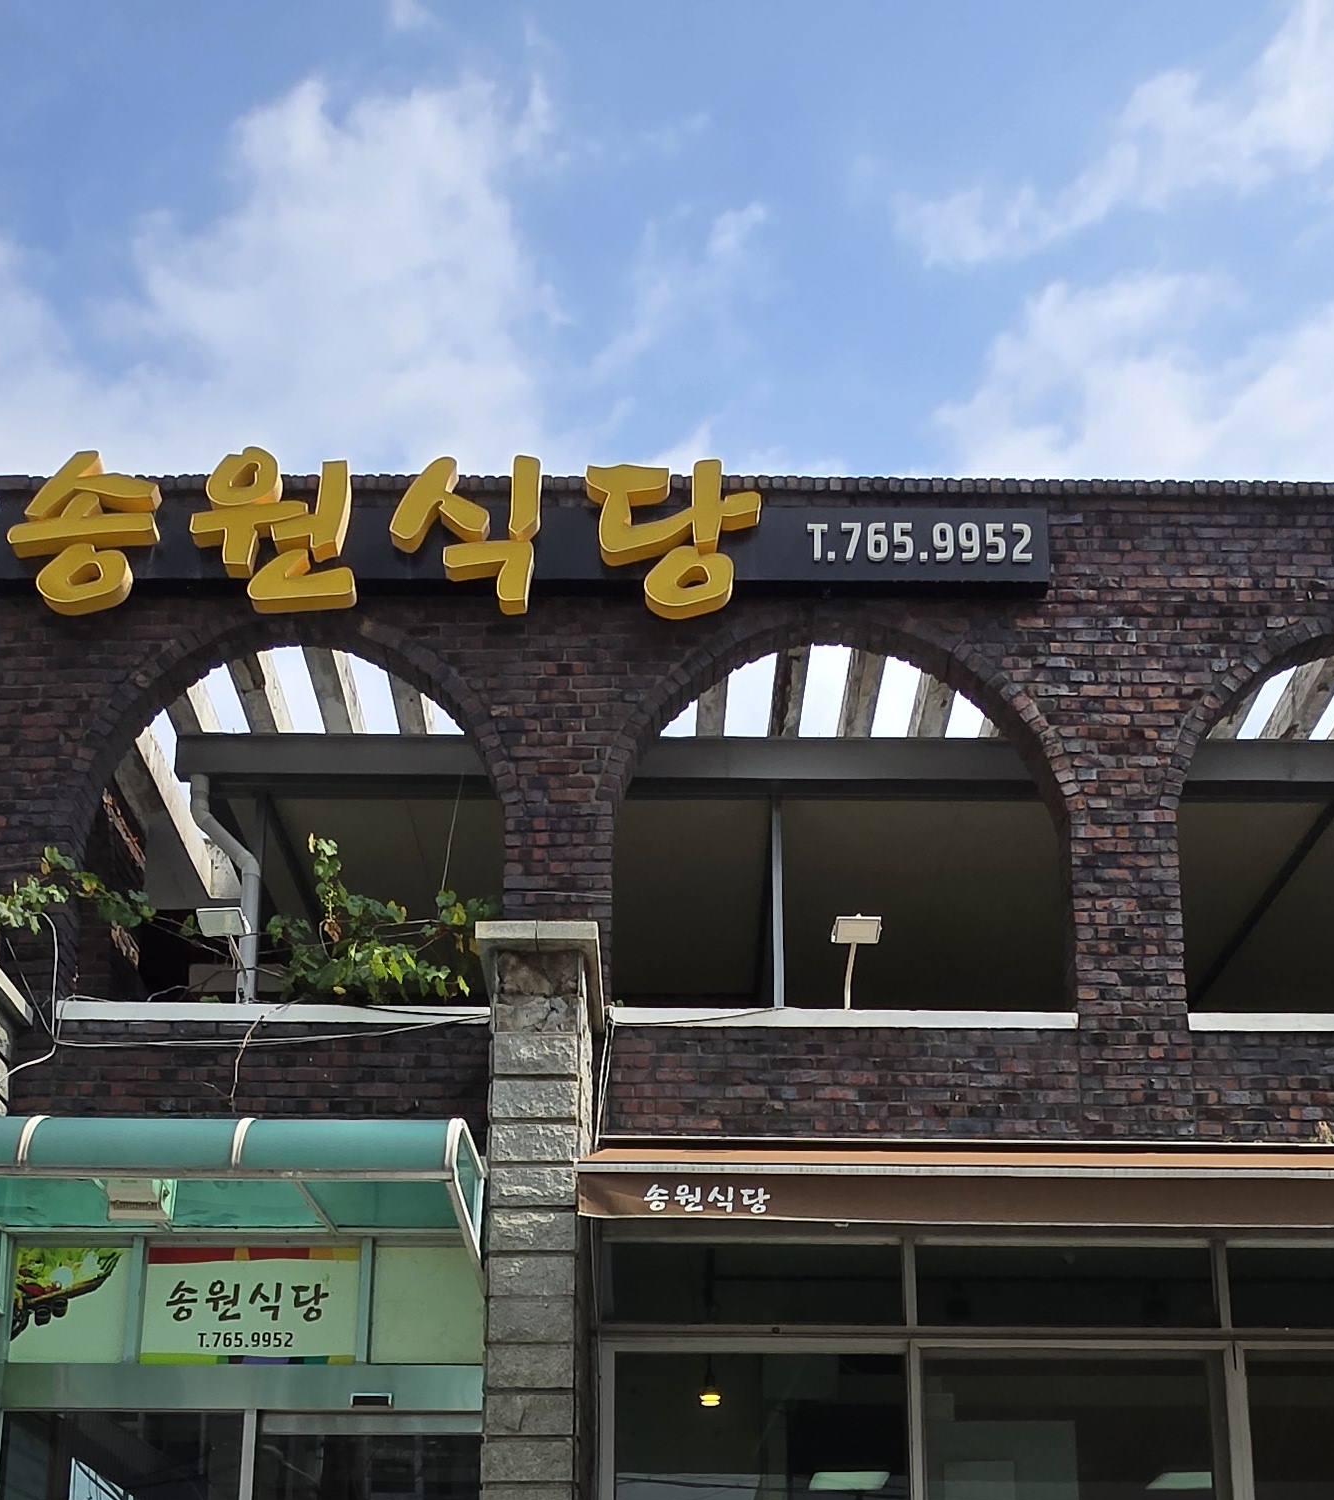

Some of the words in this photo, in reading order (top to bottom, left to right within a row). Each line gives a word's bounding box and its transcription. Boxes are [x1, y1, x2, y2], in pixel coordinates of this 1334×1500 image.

[6, 447, 762, 620] 송원식당
[805, 522, 1035, 566] T.765.9952
[643, 1183, 770, 1213] 송원식당
[166, 1280, 329, 1322] 송원식당
[198, 1332, 294, 1348] T.765.9952
